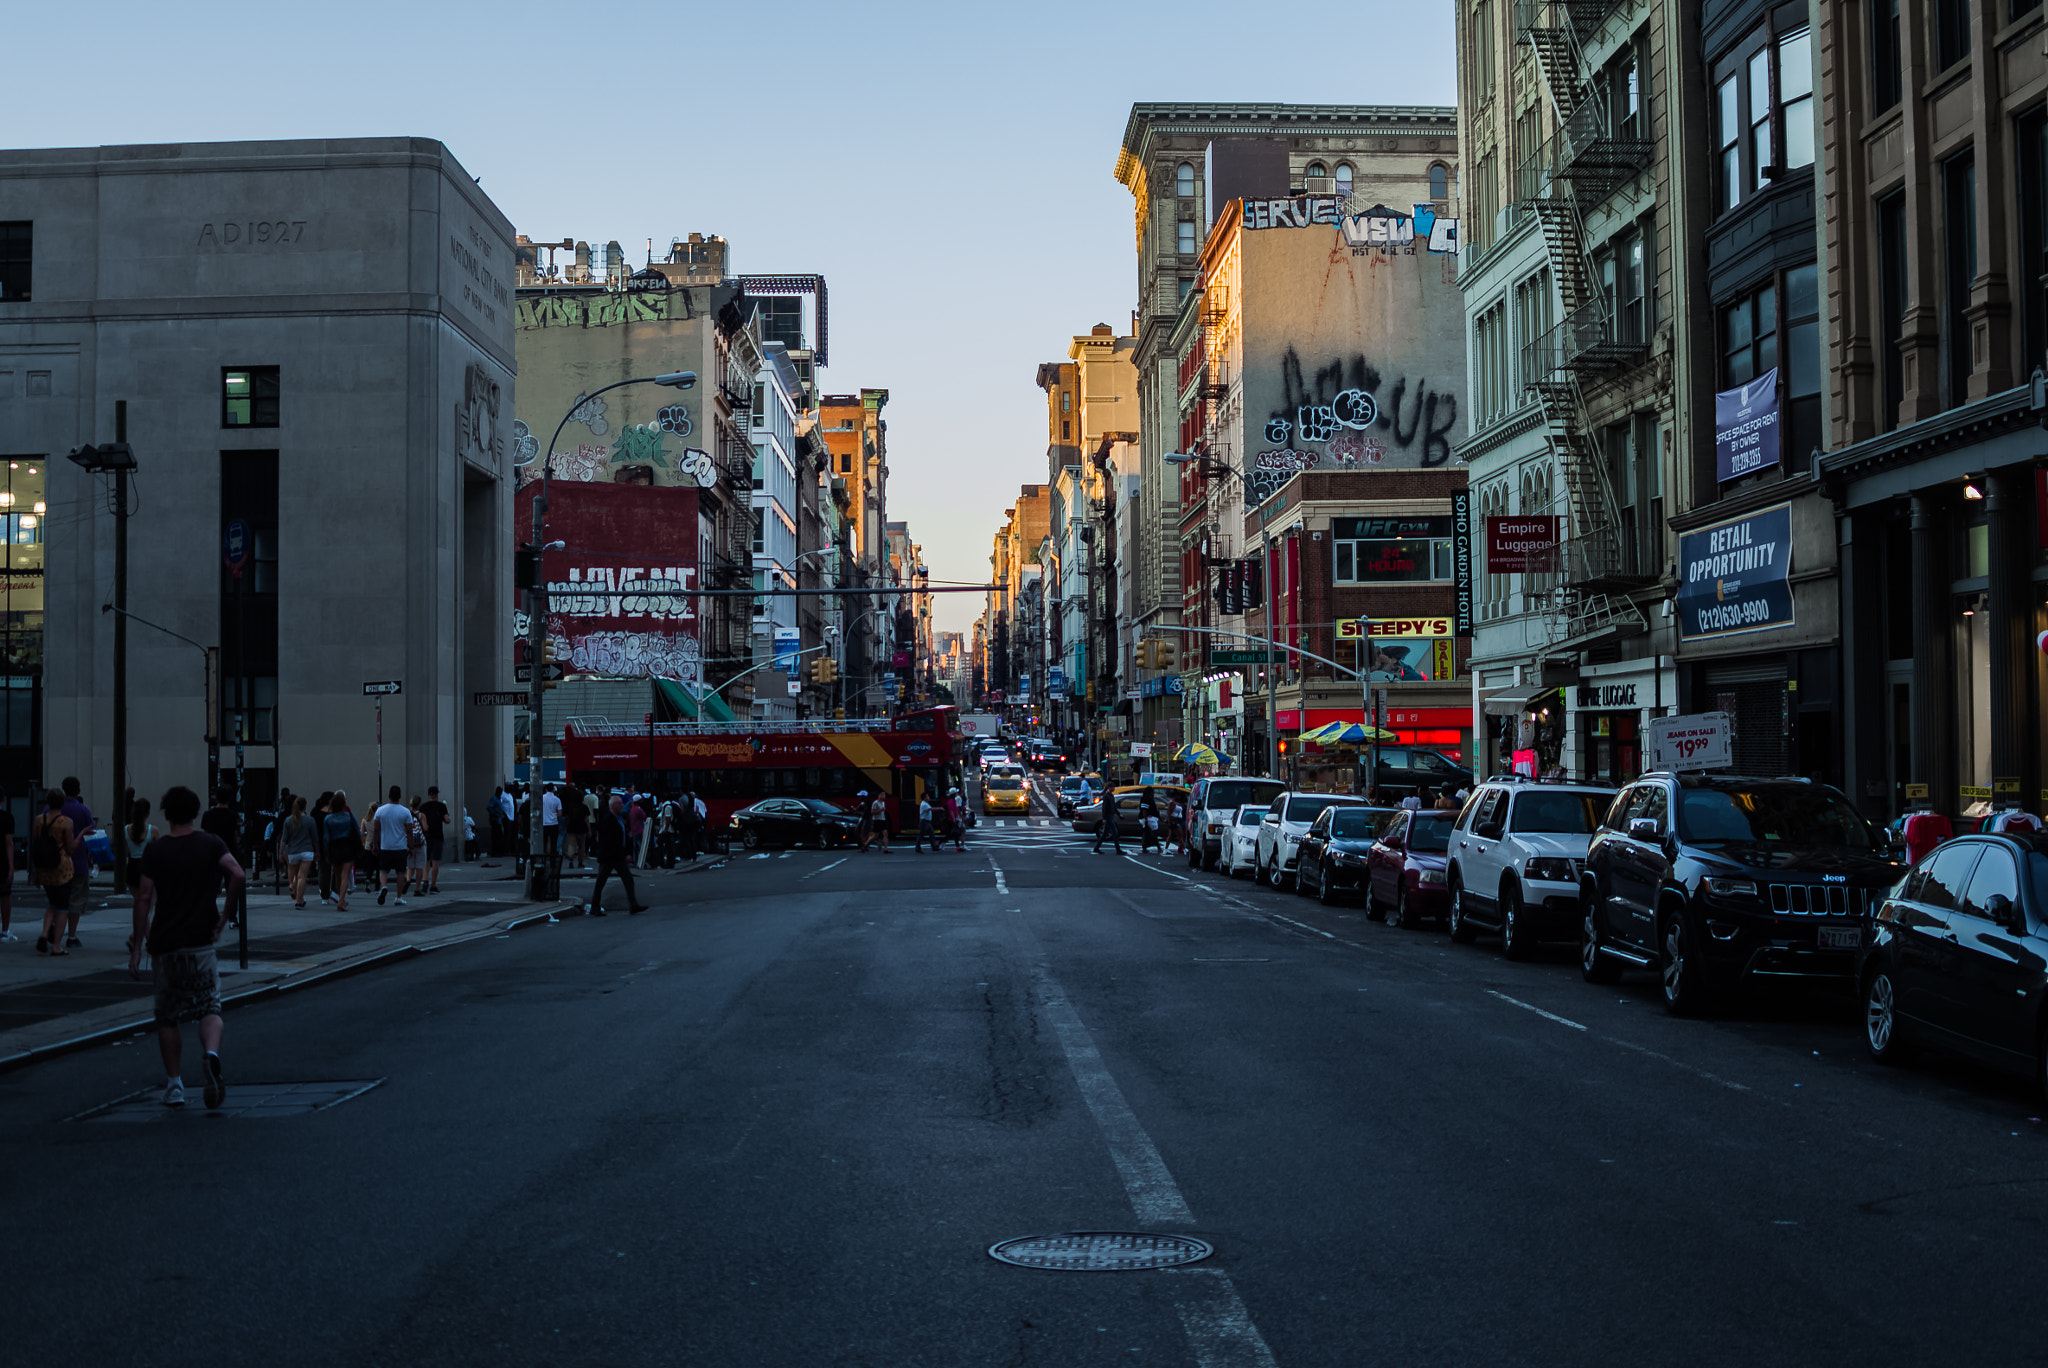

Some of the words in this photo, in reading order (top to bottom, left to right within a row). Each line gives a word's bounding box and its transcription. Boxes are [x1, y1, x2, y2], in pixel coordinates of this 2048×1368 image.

[469, 225, 479, 248] THE
[479, 236, 492, 260] FIRST
[450, 234, 480, 283] NATIONAL
[480, 266, 493, 294] CITY
[493, 278, 508, 309] BANK
[463, 284, 471, 302] OF
[471, 291, 482, 314] NEW
[483, 302, 496, 325] YORK
[1732, 422, 1750, 439] SPACE
[1750, 419, 1762, 431] FOR
[1762, 411, 1778, 426] RENT
[1731, 440, 1739, 452] BY
[1740, 432, 1760, 448] OWNER
[1455, 495, 1468, 533] SOHO
[1355, 520, 1398, 536] UFC
[1398, 522, 1429, 532] GYM
[1499, 522, 1545, 536] Empire
[1710, 522, 1752, 554] RETAIL
[1382, 547, 1400, 559] 24
[1496, 539, 1553, 553] Luggage
[1368, 560, 1415, 572] HOURS
[1457, 535, 1469, 588] GARDEN
[1689, 542, 1776, 583] OPPORTUNITY
[1458, 591, 1470, 632] HOTEL
[1698, 598, 1770, 633] (212)630-9900
[1232, 653, 1255, 662] Canal
[1258, 653, 1266, 662] St
[1438, 641, 1449, 679] SALE
[477, 694, 513, 705] LISPENARD
[516, 694, 525, 704] ST
[1603, 684, 1636, 706] LUGGAGE
[1667, 731, 1686, 739] JEANS
[1822, 873, 1846, 883] Jeep
